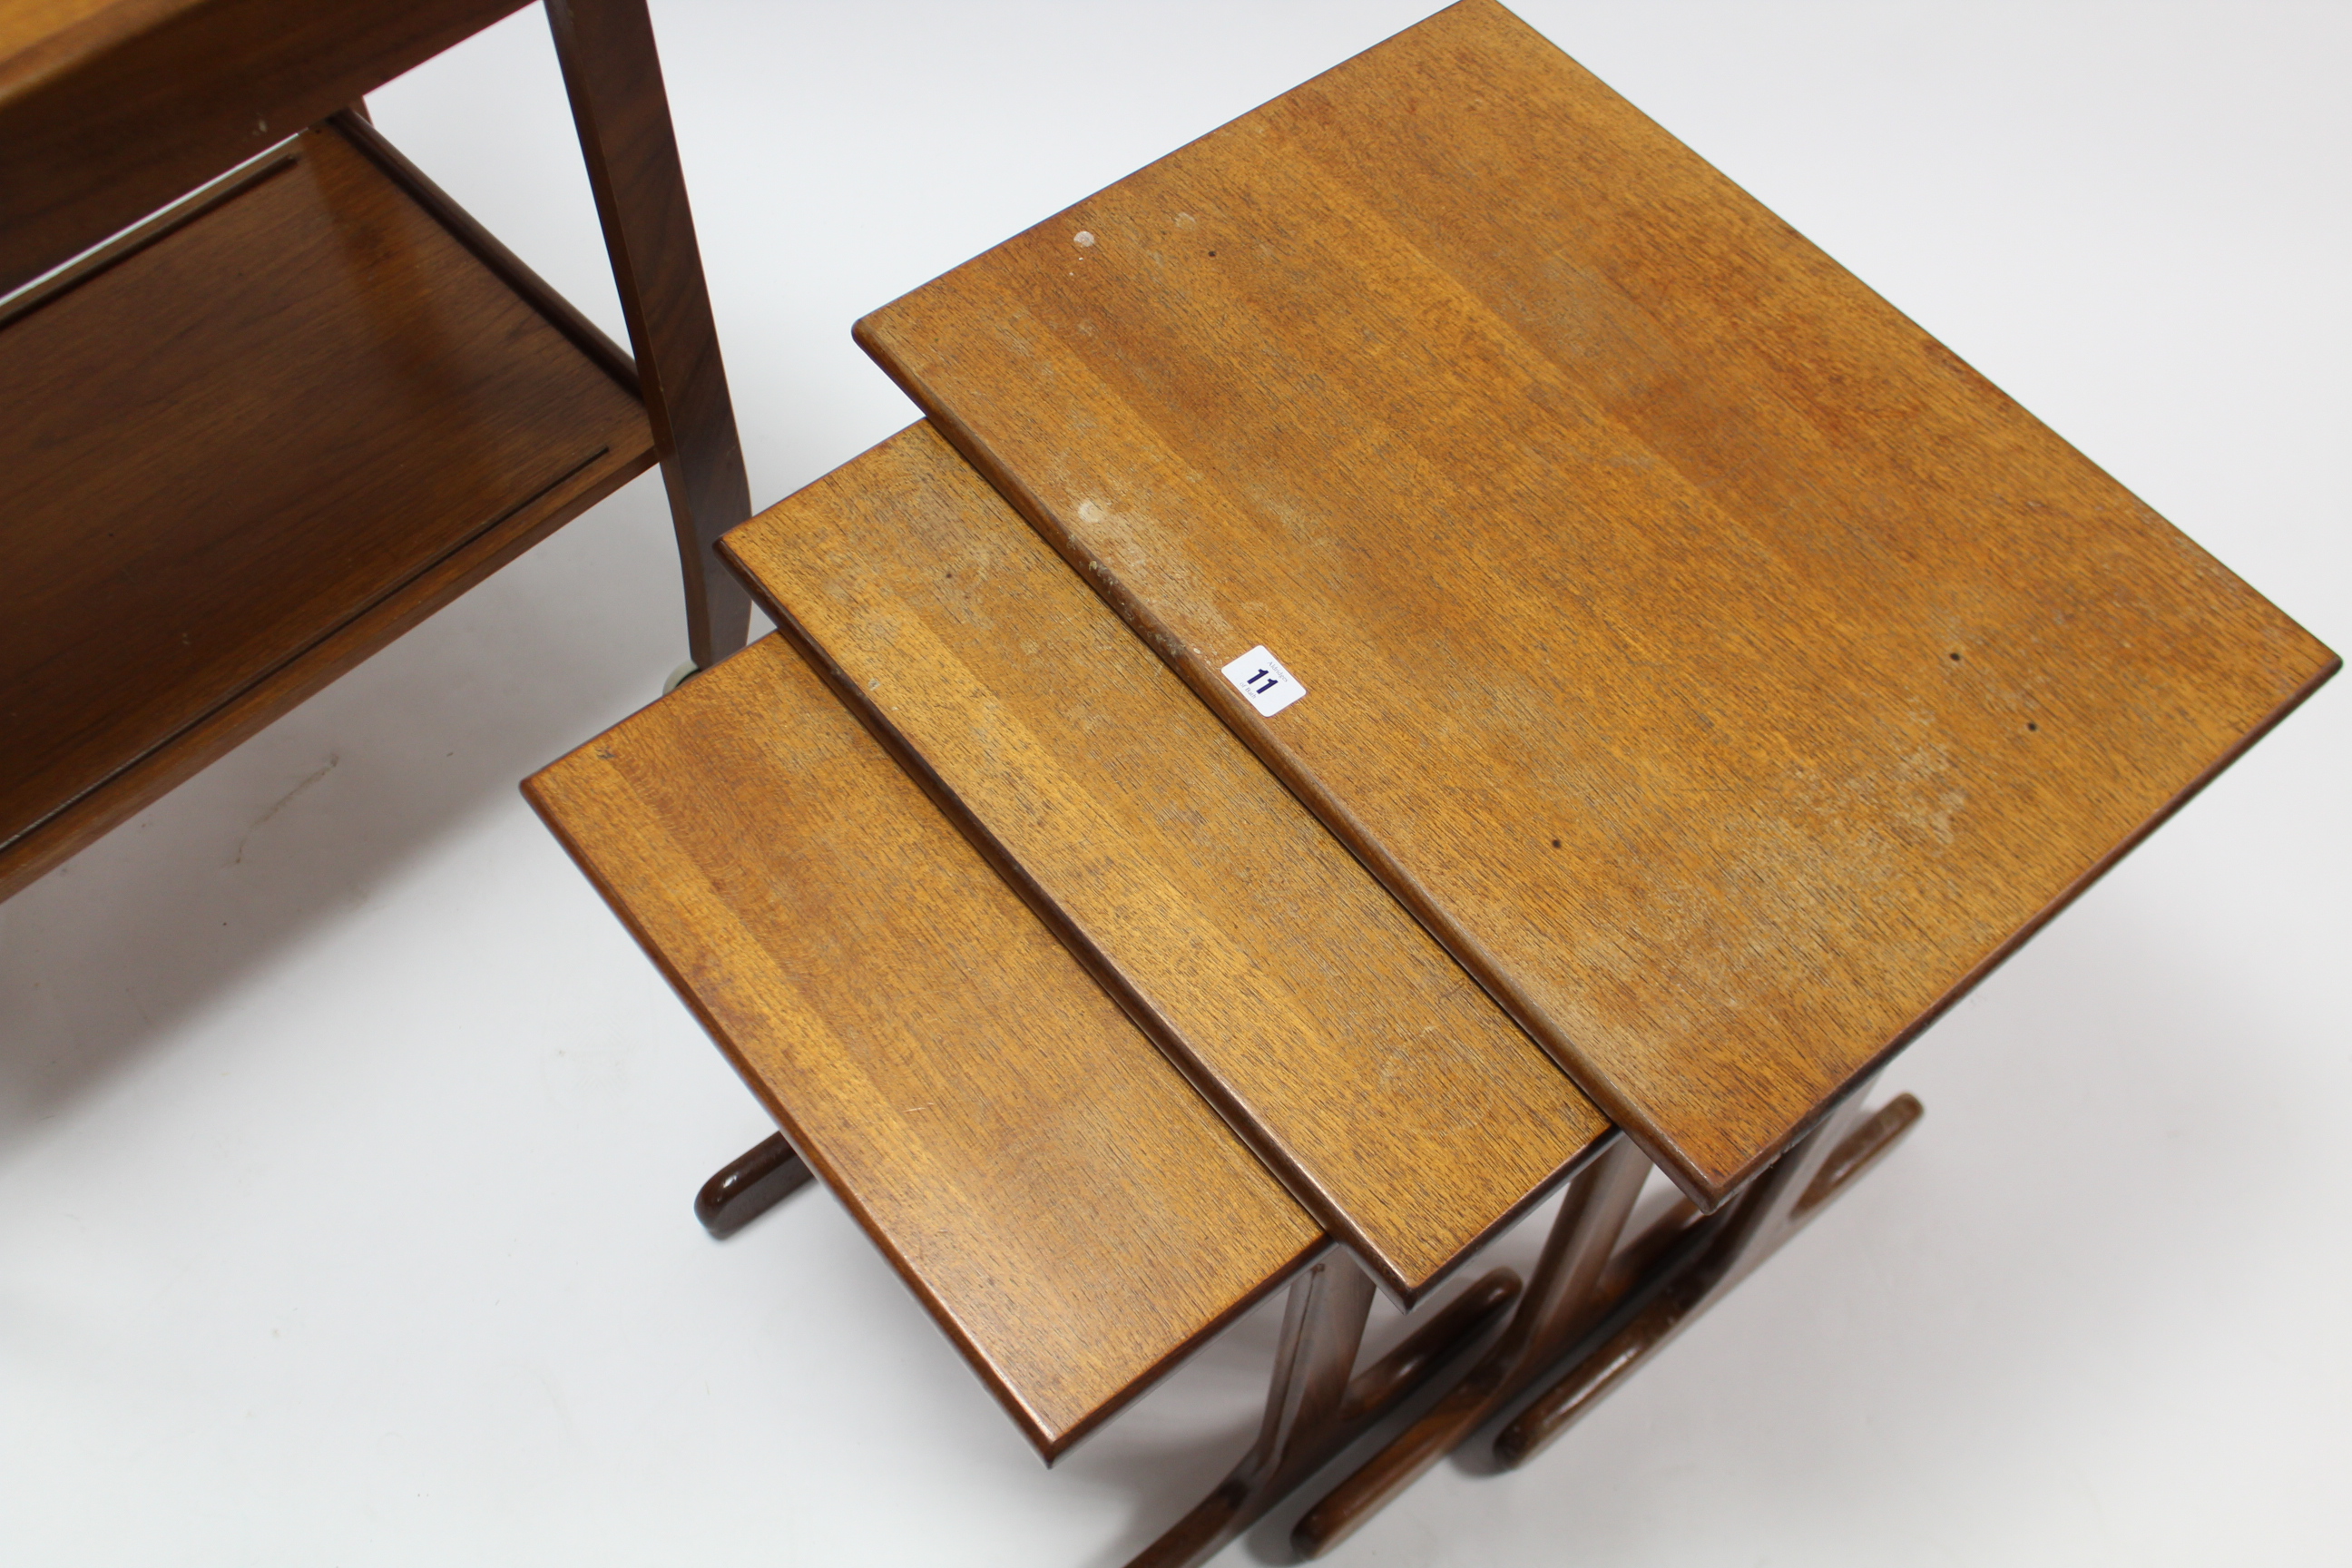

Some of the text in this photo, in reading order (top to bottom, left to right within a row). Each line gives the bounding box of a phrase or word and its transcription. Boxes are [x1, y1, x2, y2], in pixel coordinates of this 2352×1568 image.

[1247, 669, 1279, 694] 11
[1267, 661, 1288, 682] Aldridges
[1245, 687, 1257, 699] Bath
